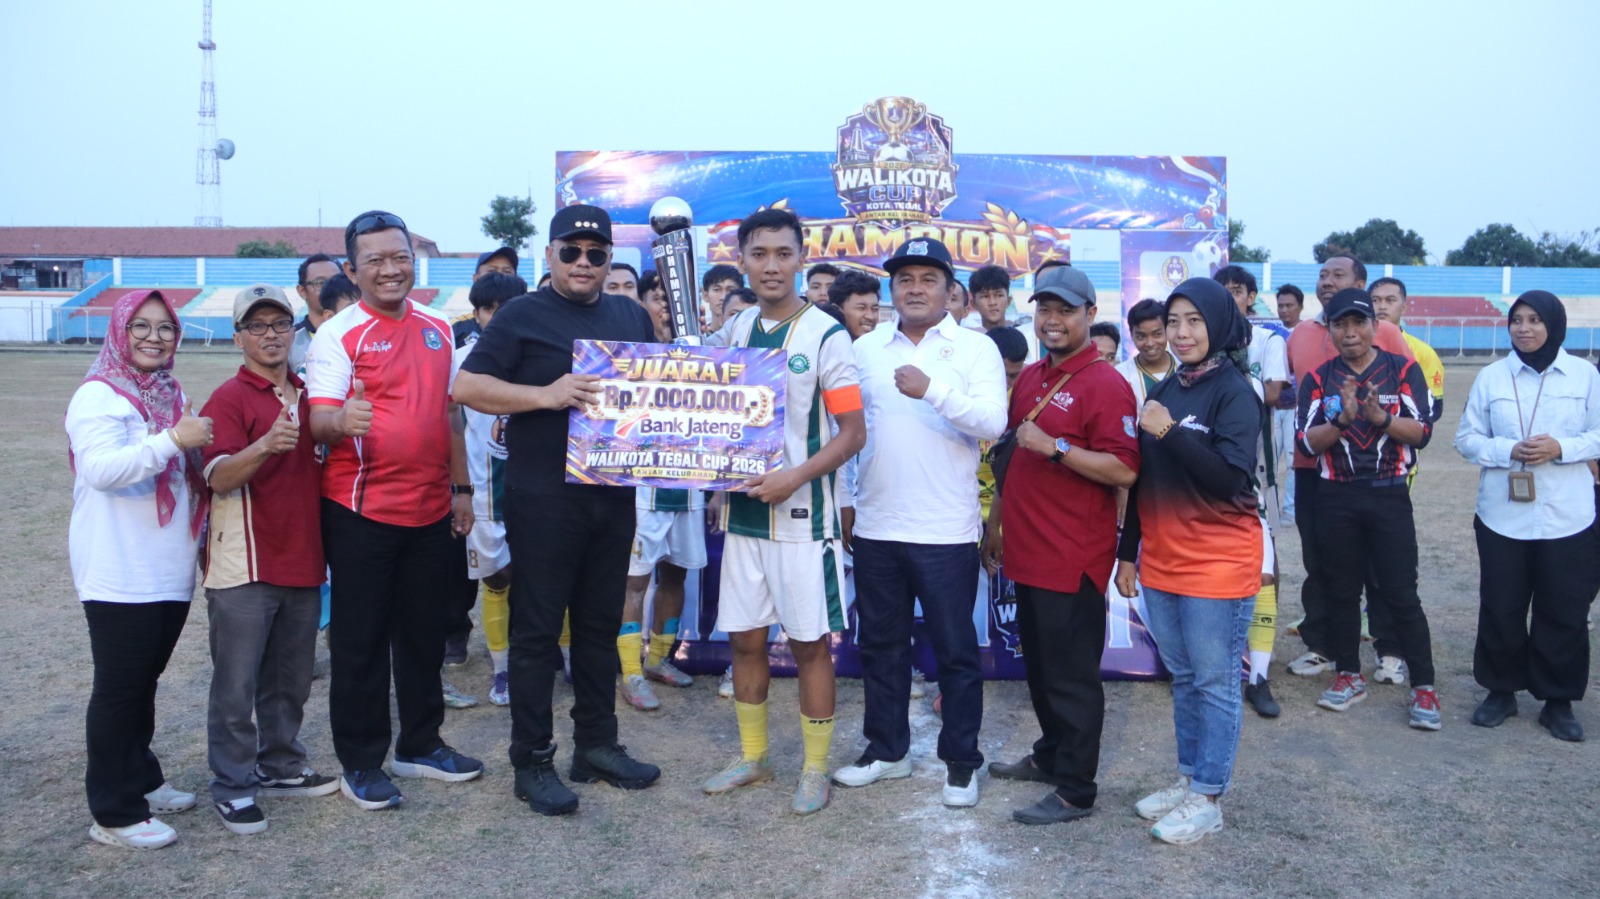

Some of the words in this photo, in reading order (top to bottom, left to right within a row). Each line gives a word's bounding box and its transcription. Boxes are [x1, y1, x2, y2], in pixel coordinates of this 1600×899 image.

[836, 167, 953, 192] WALIKOTA
[869, 185, 922, 201] CUP
[866, 202, 891, 210] KOTA
[894, 202, 922, 211] TEGAL
[665, 244, 687, 336] CHAMPION
[627, 359, 718, 382] JUARA
[604, 385, 758, 418] Rp.7.000.000,-
[640, 418, 683, 434] Bank
[685, 417, 741, 439] Jateng
[585, 451, 654, 467] WALIKOTA
[657, 452, 698, 468] TEGAL
[702, 455, 730, 470] CUP
[731, 457, 766, 474] 2026
[635, 468, 663, 476] ANTAR
[666, 470, 714, 479] KELURAHAN
[469, 549, 479, 568] 8
